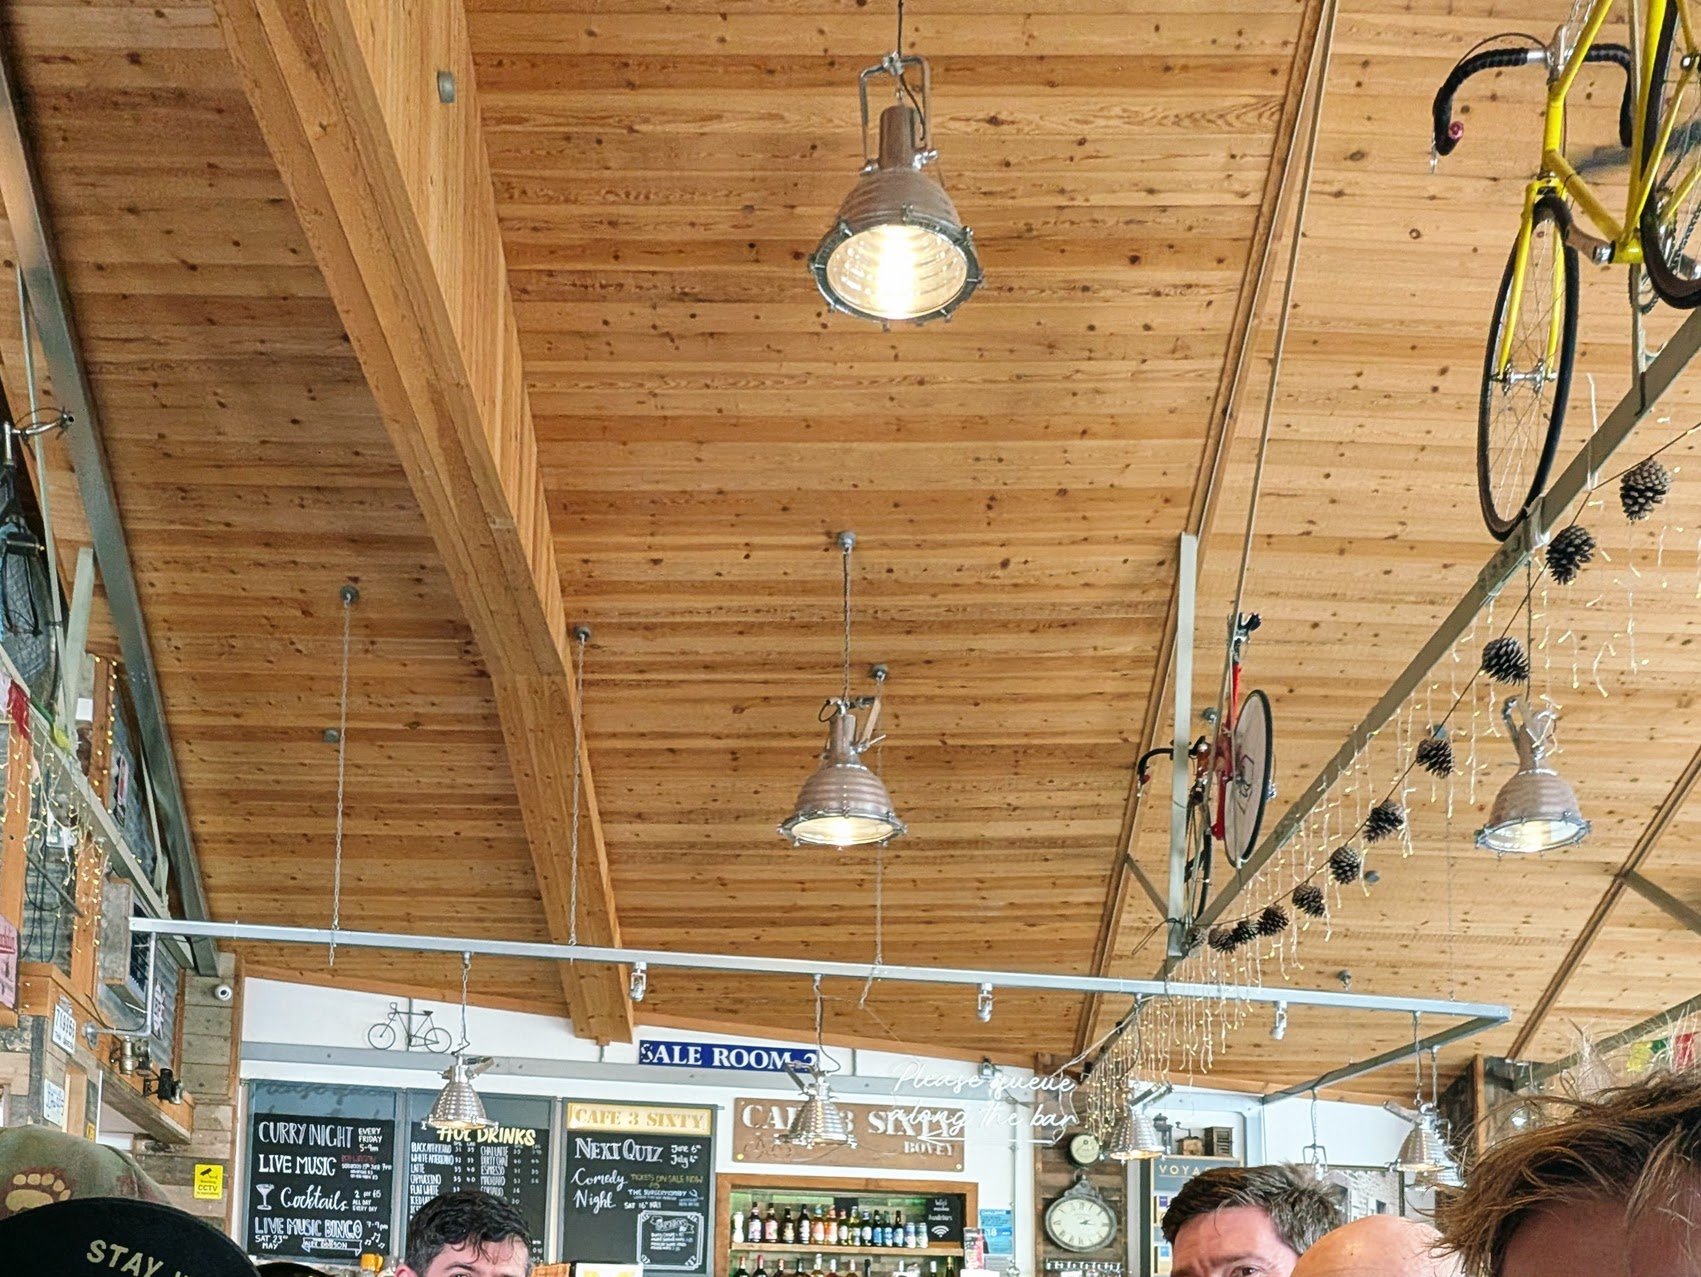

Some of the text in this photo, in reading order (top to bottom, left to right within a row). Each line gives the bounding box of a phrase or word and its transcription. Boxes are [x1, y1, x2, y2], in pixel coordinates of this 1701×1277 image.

[641, 1043, 702, 1066] SALE
[712, 1047, 792, 1069] ROOM
[894, 1059, 1077, 1100] Please queue
[576, 1108, 704, 1129] CAFE 3 SIXTY
[742, 1104, 803, 1130] CAF
[868, 1110, 953, 1138] SIXTY
[891, 1100, 967, 1135] along
[1030, 1104, 1078, 1127] bar
[258, 1121, 353, 1148] CURRY NIGHT
[358, 1127, 381, 1136] EVERY
[358, 1135, 383, 1144] FRIDAY
[477, 1128, 537, 1146] DRINKS
[575, 1137, 663, 1163] NEXT QUIZ
[670, 1144, 689, 1153] June
[904, 1141, 954, 1156] BOVEY
[258, 1154, 292, 1174] LIVE
[295, 1156, 337, 1176] MUSIC
[410, 1163, 425, 1174] LATTE
[480, 1165, 505, 1175] ESPRESSO
[670, 1155, 690, 1169] July
[410, 1174, 441, 1185] CAPPUCCINO
[570, 1167, 628, 1191] Comedy
[198, 1184, 218, 1192] CCTV
[354, 1189, 360, 1198] 2
[280, 1184, 350, 1212] Cocktails
[573, 1189, 616, 1214] Night
[624, 1201, 636, 1209] SAT
[254, 1216, 363, 1240] LIVE MUSIC BINGO
[254, 1234, 270, 1243] SAT
[262, 1242, 279, 1250] MAY
